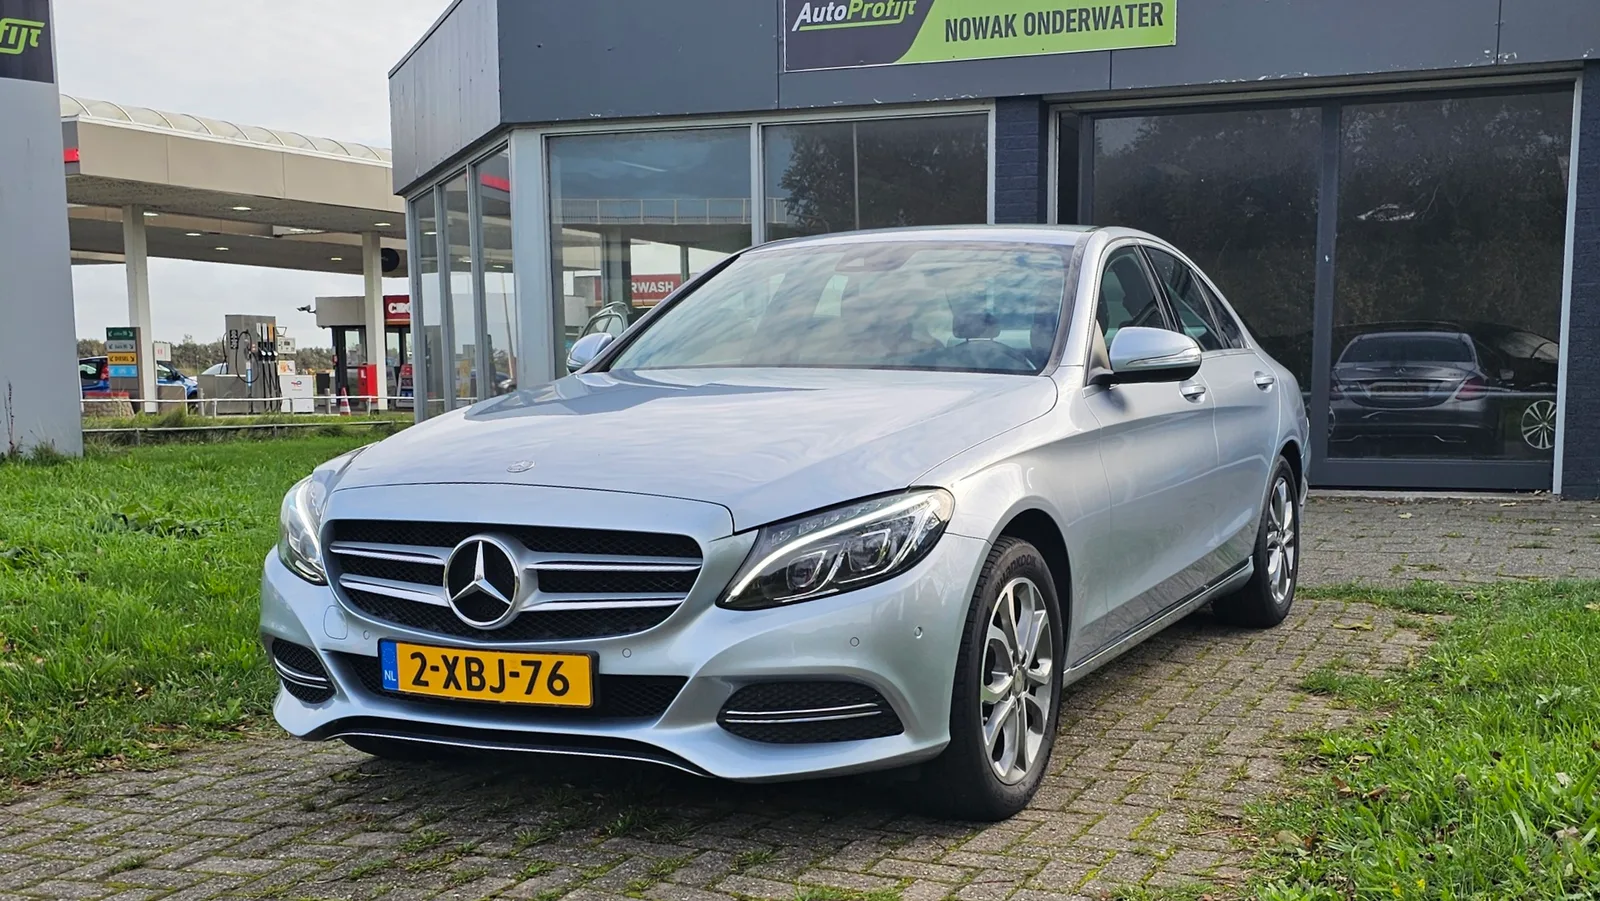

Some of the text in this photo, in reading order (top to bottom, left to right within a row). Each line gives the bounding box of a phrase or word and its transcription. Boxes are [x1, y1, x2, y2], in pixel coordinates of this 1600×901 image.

[945, 2, 1164, 43] NOWAK ONDERWATER
[384, 651, 570, 697] NL 2-XBJ-76
